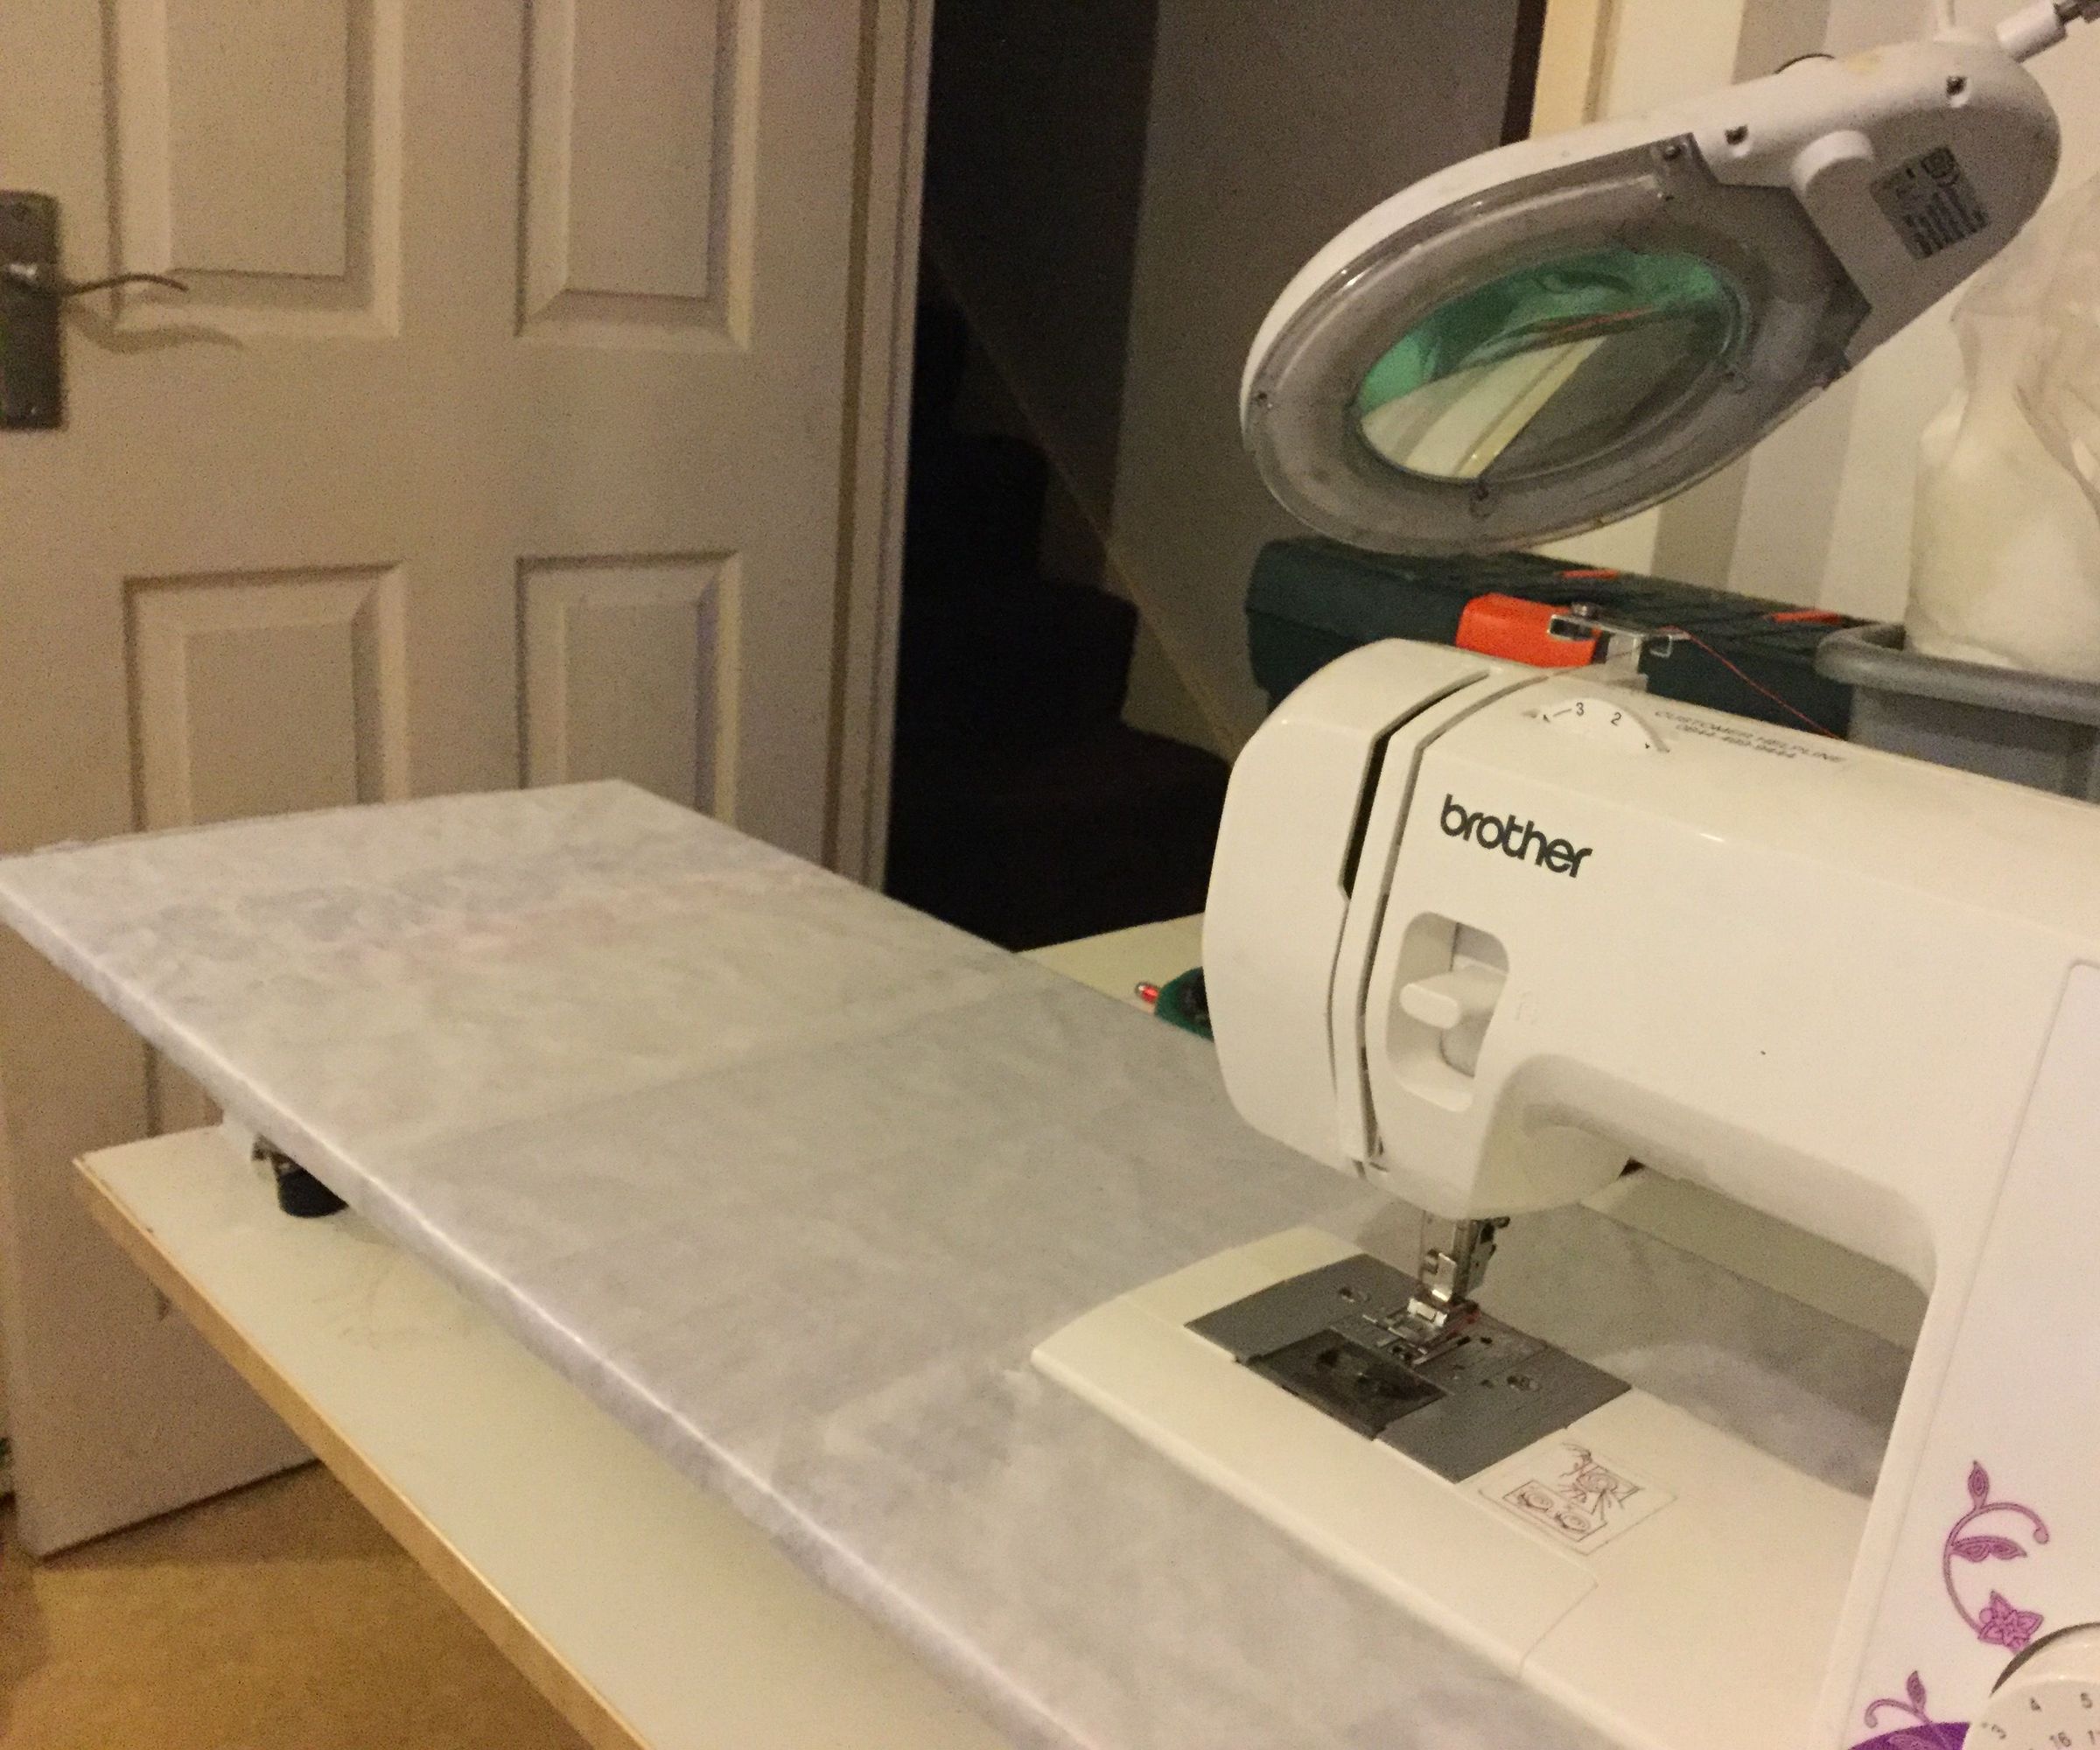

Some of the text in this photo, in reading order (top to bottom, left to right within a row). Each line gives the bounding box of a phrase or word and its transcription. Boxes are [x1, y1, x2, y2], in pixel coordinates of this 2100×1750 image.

[1575, 702, 1585, 717] 3
[1610, 711, 1622, 726] 2
[1440, 793, 1593, 878] brother
[2080, 1692, 2094, 1709] 5
